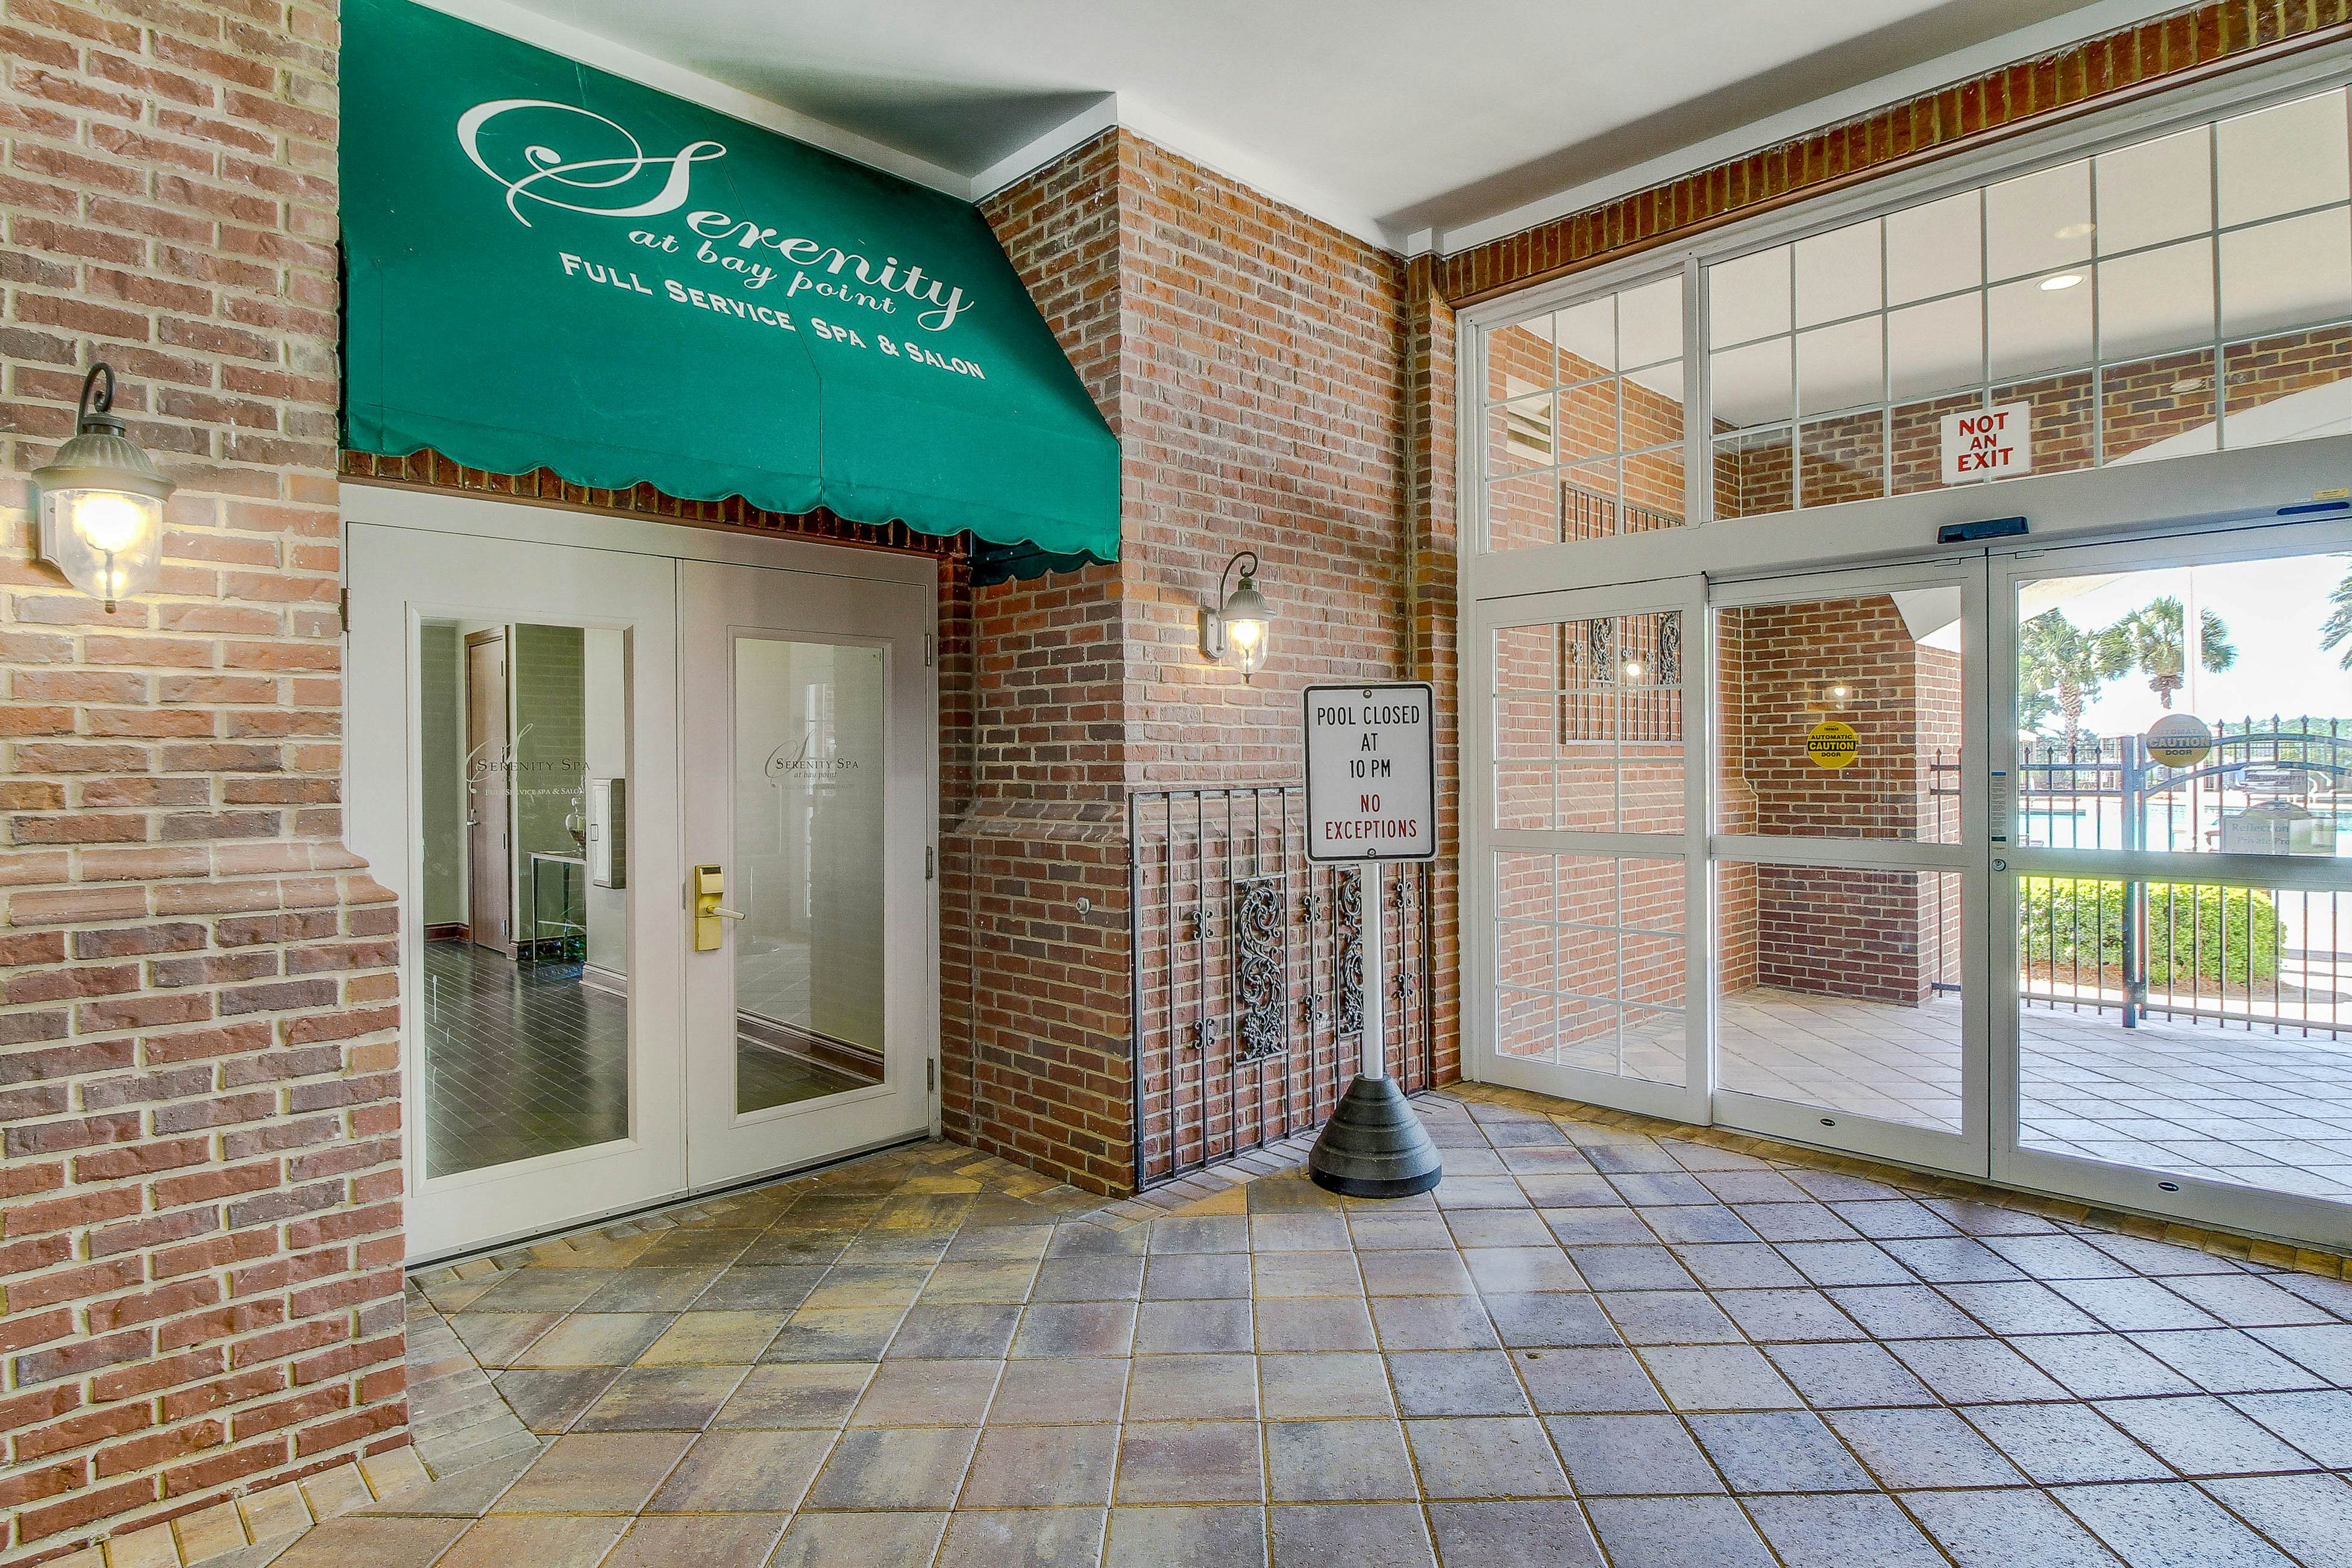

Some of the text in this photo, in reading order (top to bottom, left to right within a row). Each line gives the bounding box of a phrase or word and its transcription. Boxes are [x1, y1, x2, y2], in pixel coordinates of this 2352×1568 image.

[456, 98, 974, 332] Serenity
[628, 230, 896, 315] at bay point
[558, 251, 986, 380] FULL SERVICE SPA & SALON
[1959, 412, 2009, 436] NOT
[1970, 433, 1996, 451] AN
[1958, 447, 2013, 472] EXIT
[1317, 705, 1420, 726] POOL CLOSED
[1361, 733, 1378, 751] AT
[1809, 742, 1854, 750] CAUTION
[2149, 737, 2210, 747] CAUTION
[477, 758, 591, 771] SERENITY SPA
[776, 757, 859, 769] SERENITY SPA
[1349, 759, 1391, 779] 10 PM
[1360, 794, 1380, 813] NO
[1325, 819, 1417, 840] EXCEPTIONS
